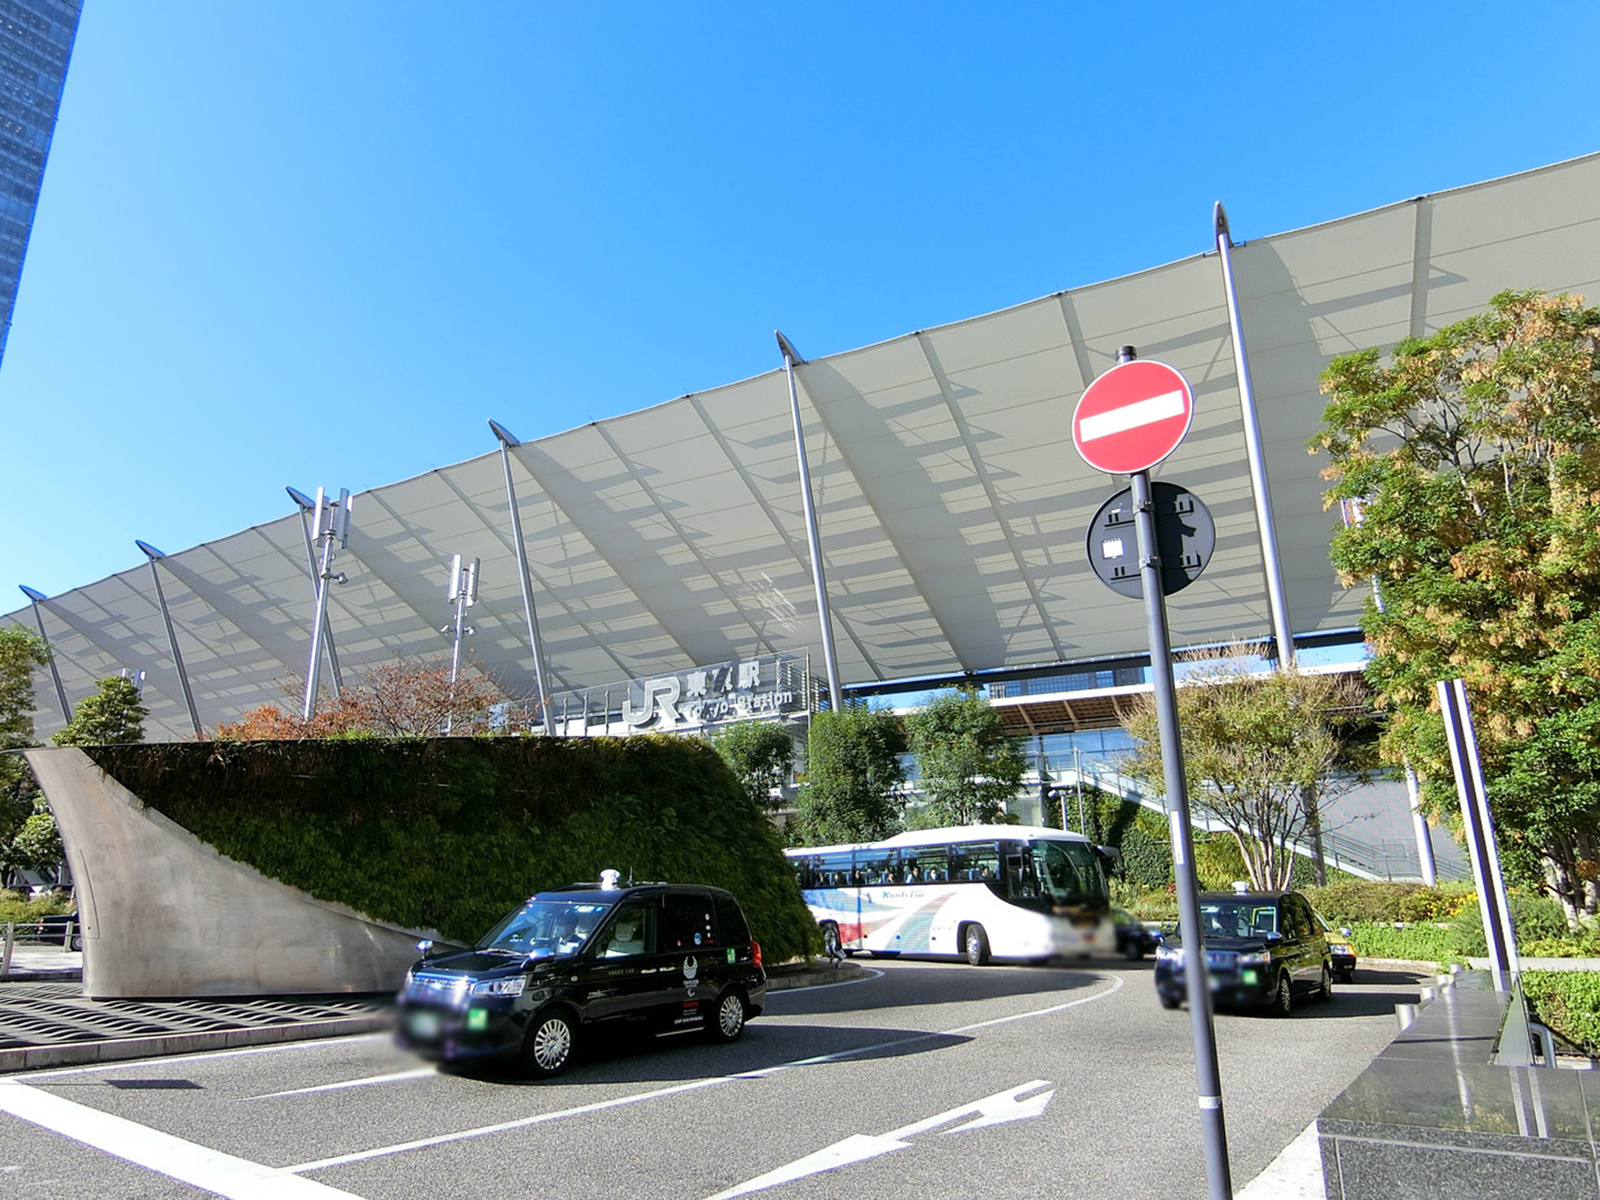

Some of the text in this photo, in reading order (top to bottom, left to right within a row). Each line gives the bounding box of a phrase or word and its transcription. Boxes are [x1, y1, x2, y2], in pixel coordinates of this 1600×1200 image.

[622, 676, 681, 726] JR
[689, 691, 793, 719] Tokyo Station
